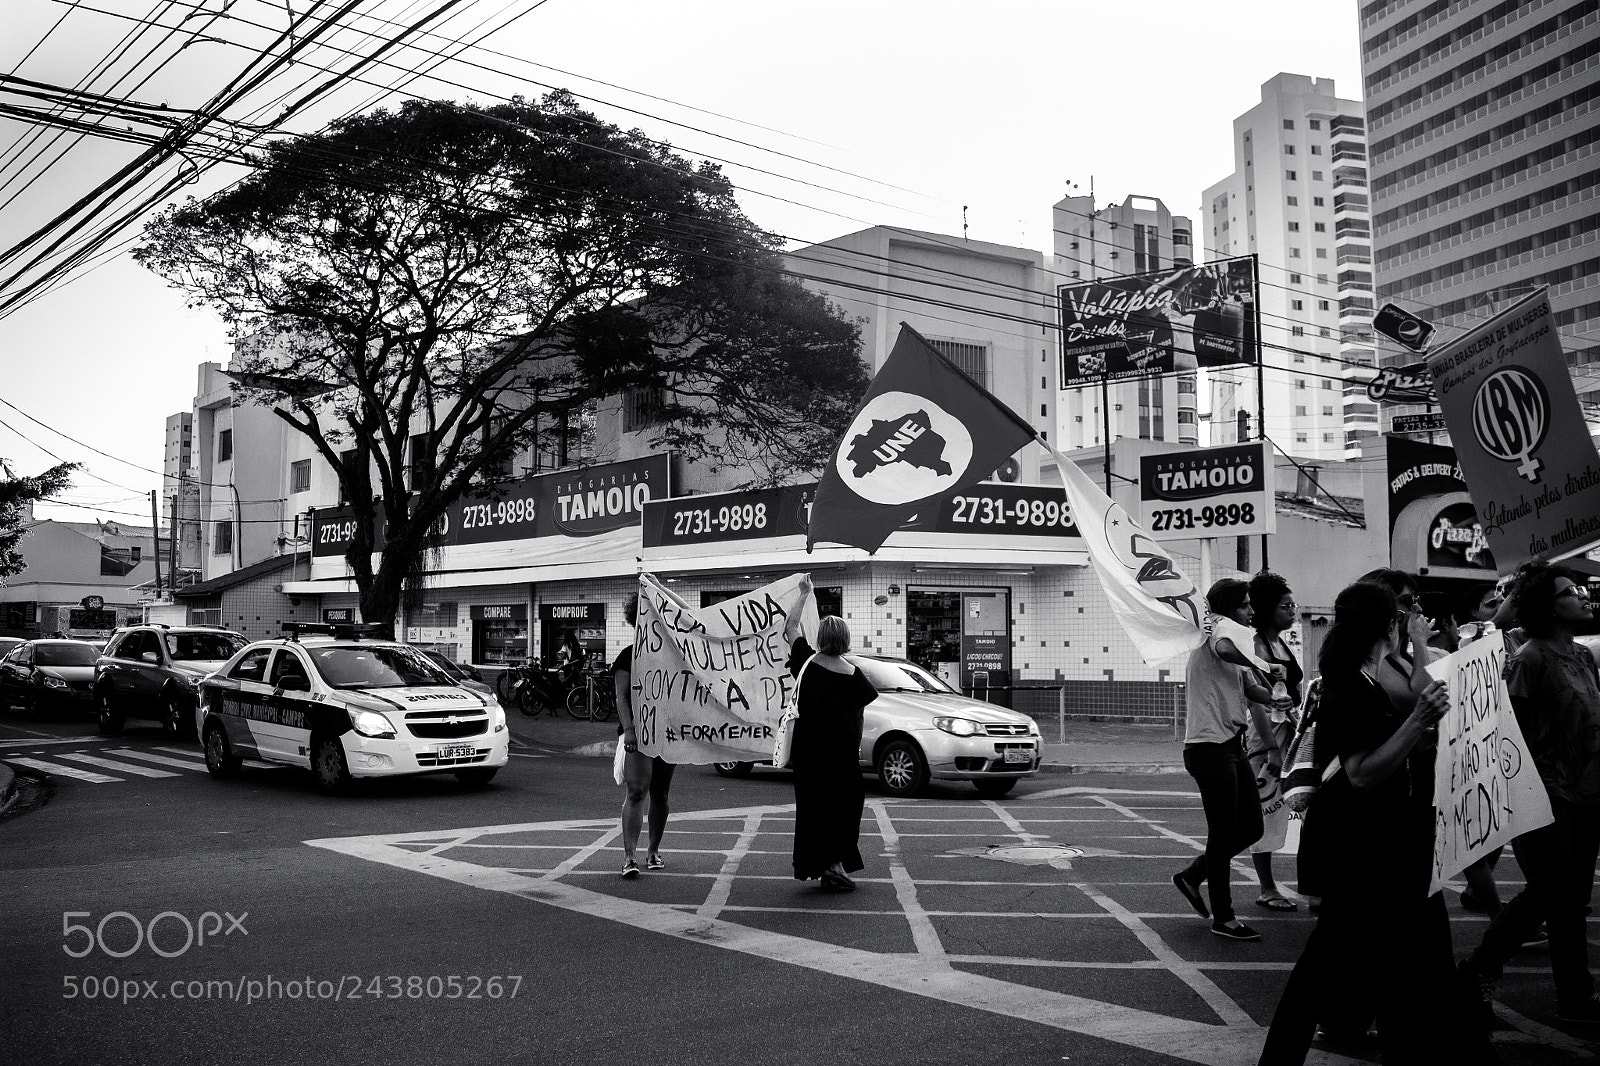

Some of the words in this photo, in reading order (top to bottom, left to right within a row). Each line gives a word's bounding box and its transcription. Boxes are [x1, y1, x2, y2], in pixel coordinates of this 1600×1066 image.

[1432, 357, 1455, 378] UNIÃO
[1454, 334, 1497, 366] BRASILEIRA
[1496, 324, 1508, 342] DE
[1507, 302, 1549, 335] MULHERES
[1442, 365, 1477, 394] Campos
[1478, 356, 1494, 370] dos
[872, 419, 926, 462] UNE
[1403, 420, 1447, 433] 2735-33
[1158, 456, 1252, 471] DROGARIAS
[1158, 465, 1254, 491] TAMOIO
[1390, 469, 1414, 494] FATIAS
[1413, 466, 1420, 478] &
[1420, 463, 1452, 476] DELIVERY
[557, 470, 649, 494] DROGARIAS
[463, 497, 535, 528] 2731-9898
[557, 482, 651, 522] TAMOIO
[952, 495, 1076, 528] 2731-9898
[1152, 502, 1256, 531] 2731-9898
[1483, 494, 1533, 535] Lutando
[1564, 465, 1600, 496] direito
[673, 502, 767, 536] 2731-9898
[1529, 533, 1548, 556] das
[483, 606, 512, 618] COMPARE
[552, 606, 588, 619] COMPROVE
[720, 592, 787, 635] VIDA
[634, 619, 663, 661] DAS
[1460, 736, 1480, 787] NÃO
[1454, 774, 1500, 862] MEDO
